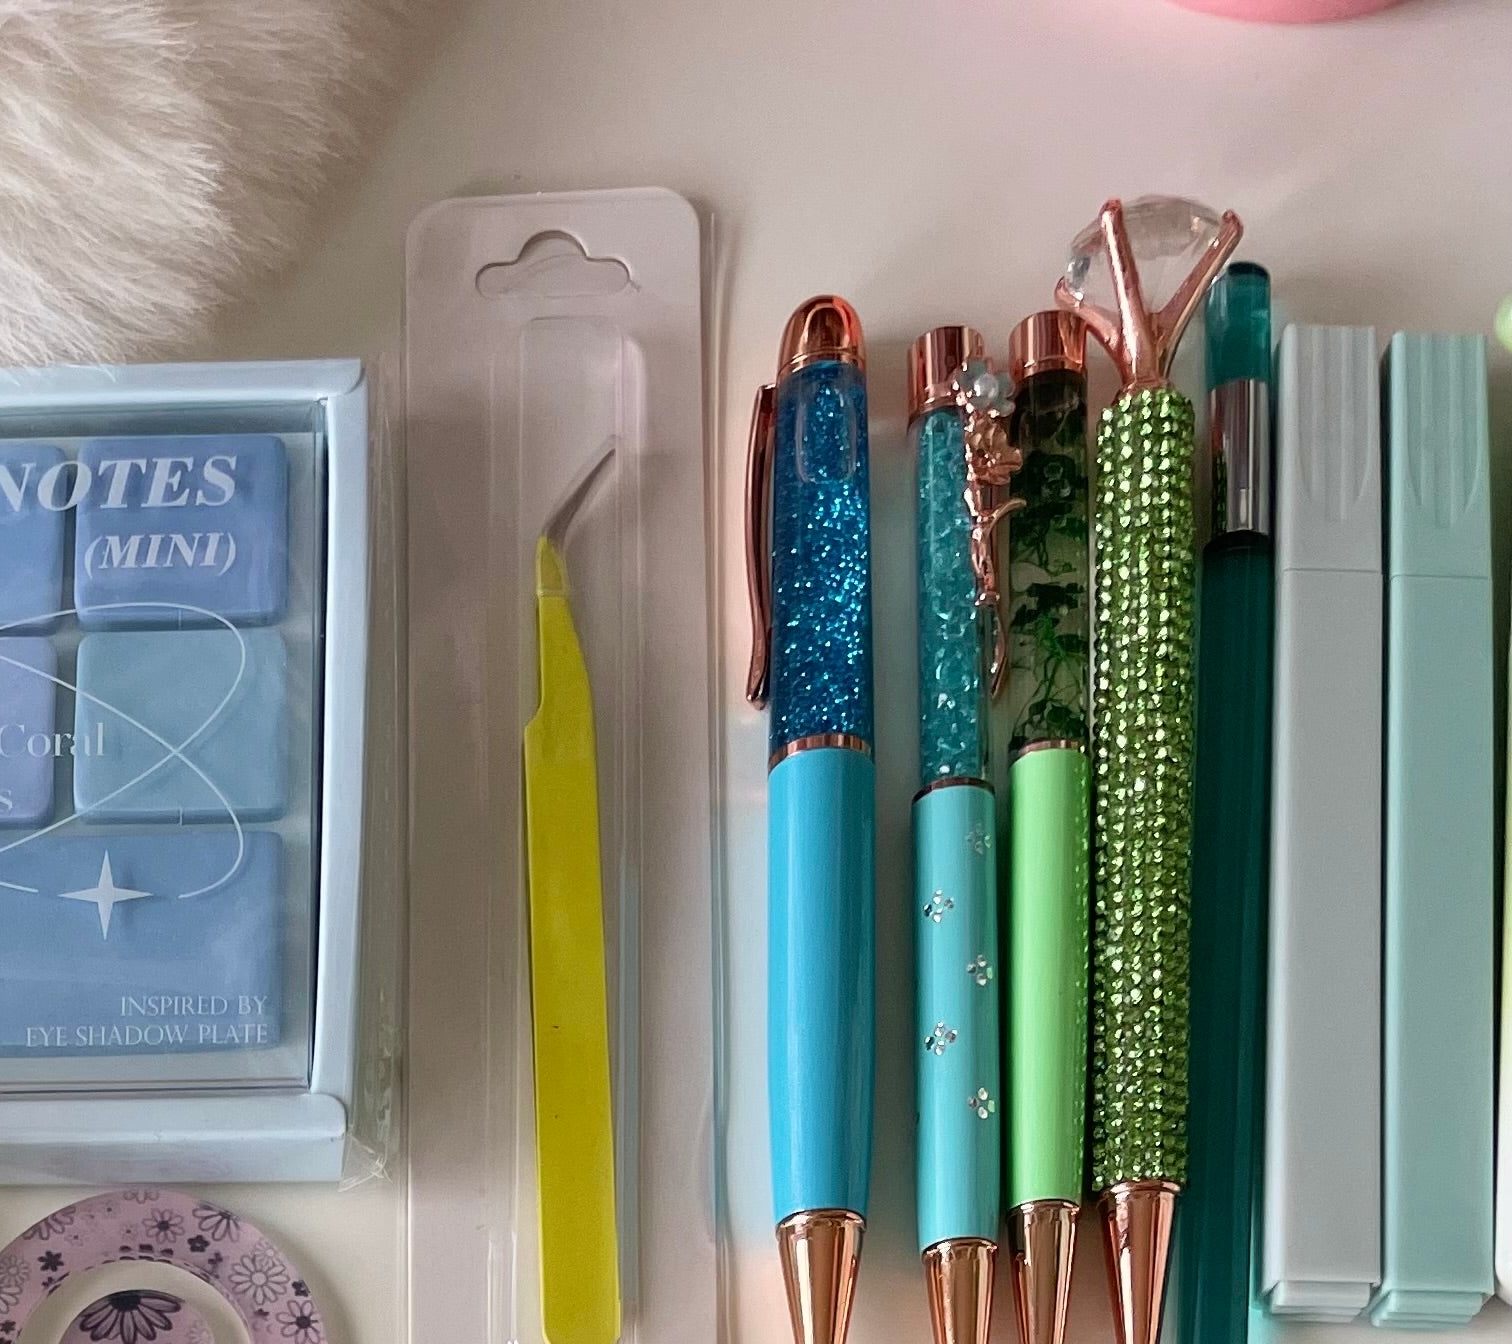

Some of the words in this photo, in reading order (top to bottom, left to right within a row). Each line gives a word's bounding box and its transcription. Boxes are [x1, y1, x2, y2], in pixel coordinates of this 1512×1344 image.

[83, 531, 236, 577] (MINI)
[120, 995, 228, 1017] INSPIRED
[238, 995, 269, 1016] BY
[25, 1025, 68, 1048] EYE
[75, 1024, 190, 1048] SHADOW
[197, 1023, 269, 1045] PLATE
